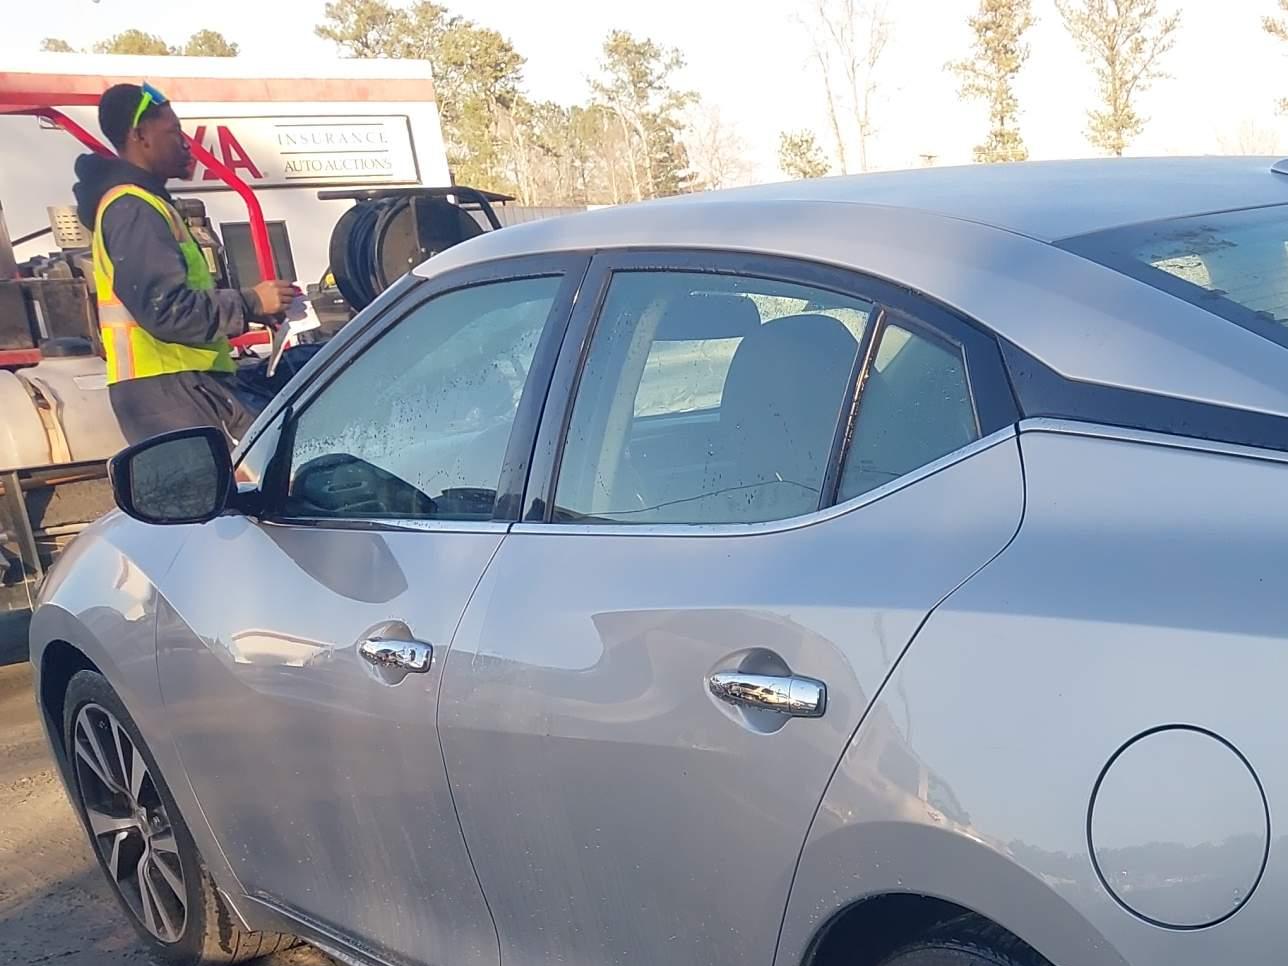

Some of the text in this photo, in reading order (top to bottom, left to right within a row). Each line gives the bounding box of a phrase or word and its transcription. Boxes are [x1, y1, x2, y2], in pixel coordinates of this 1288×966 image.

[277, 131, 389, 146] INSURANCE
[284, 157, 393, 173] AUTO AUCTIONS
